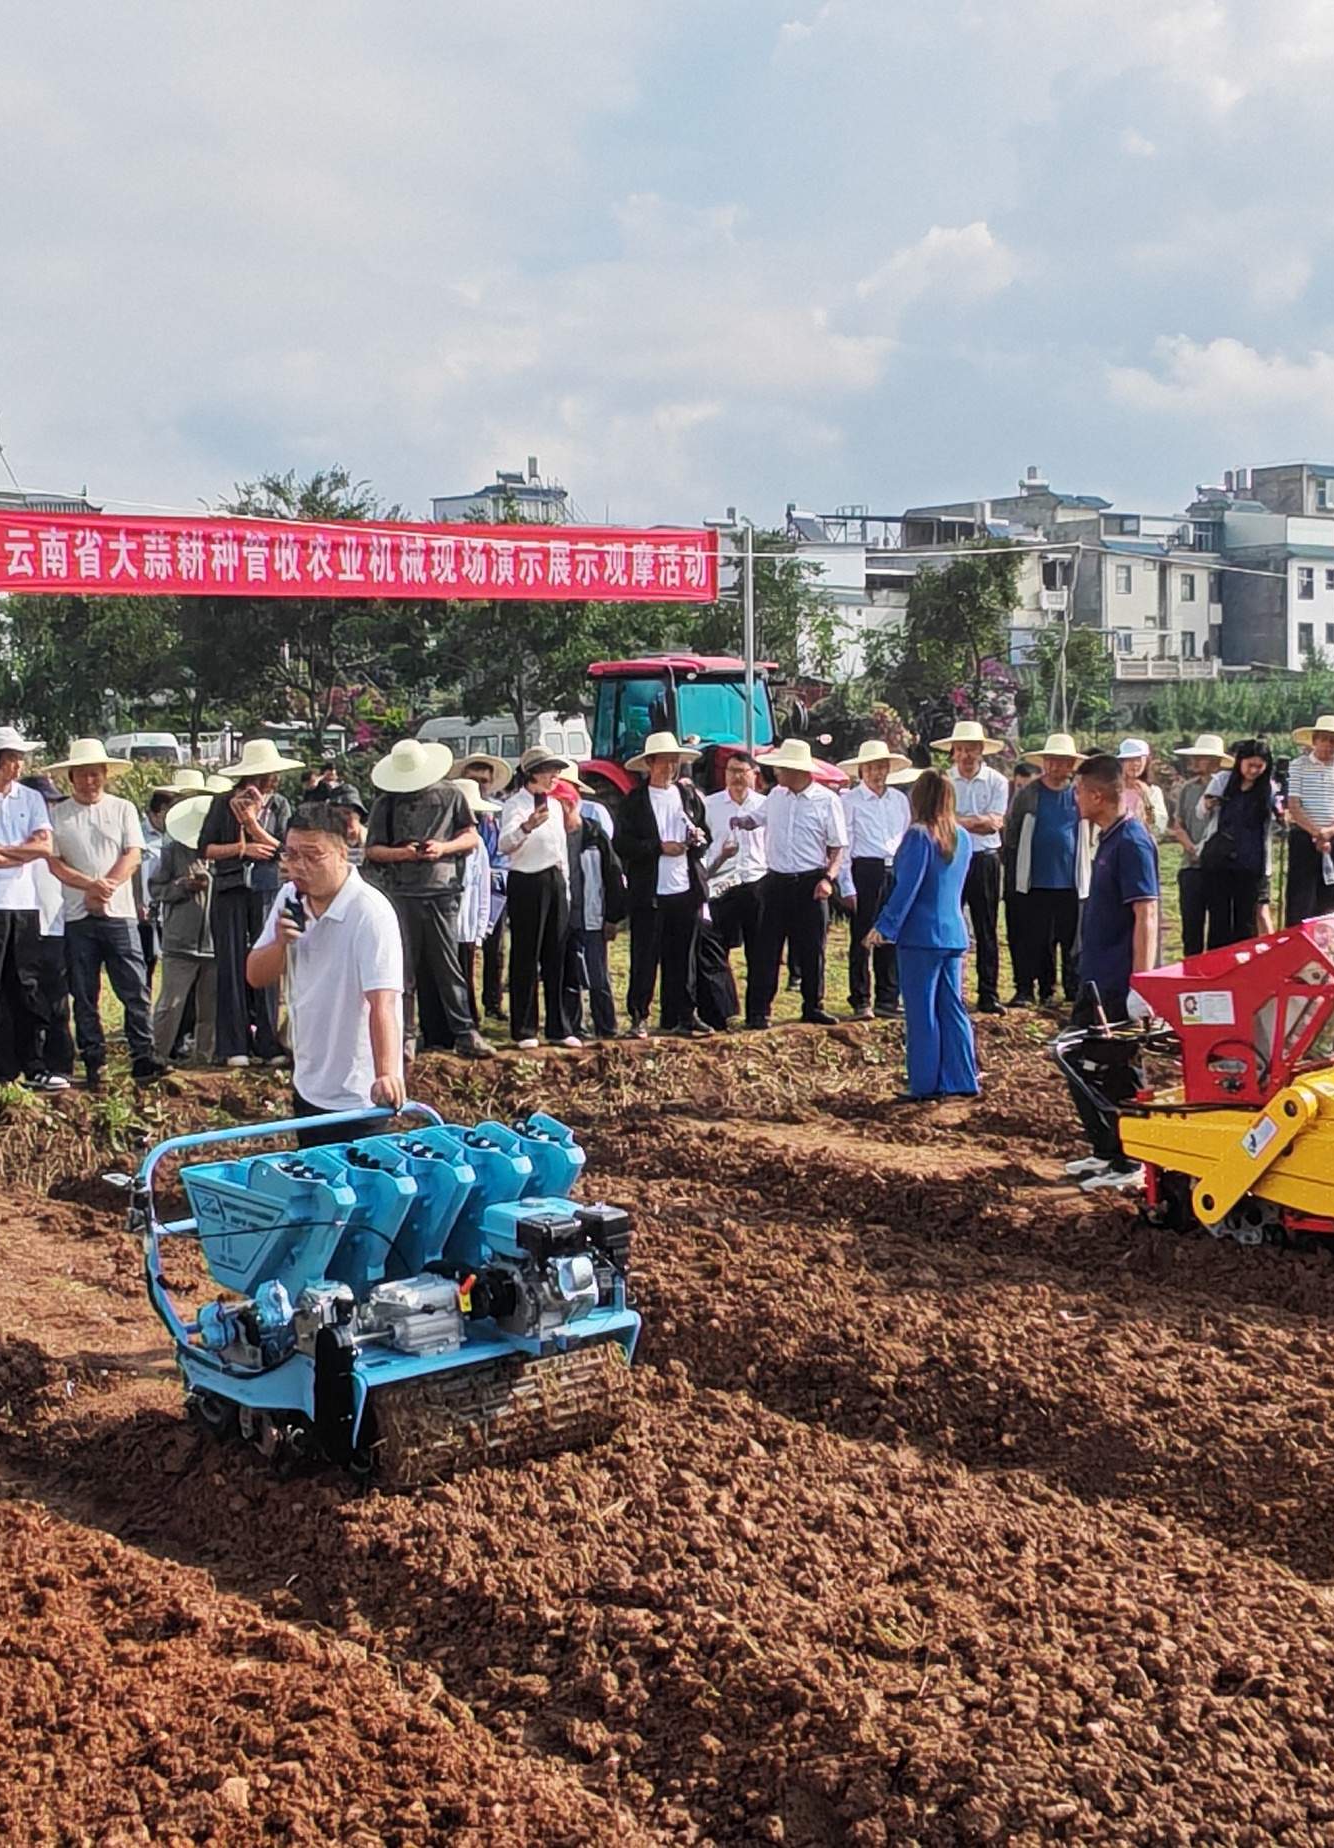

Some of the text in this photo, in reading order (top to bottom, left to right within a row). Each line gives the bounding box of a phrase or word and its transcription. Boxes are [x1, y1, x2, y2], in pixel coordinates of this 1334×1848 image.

[3, 528, 708, 588] 云南省大蒜耕种管收农业机械现场演示展示观摩活动
